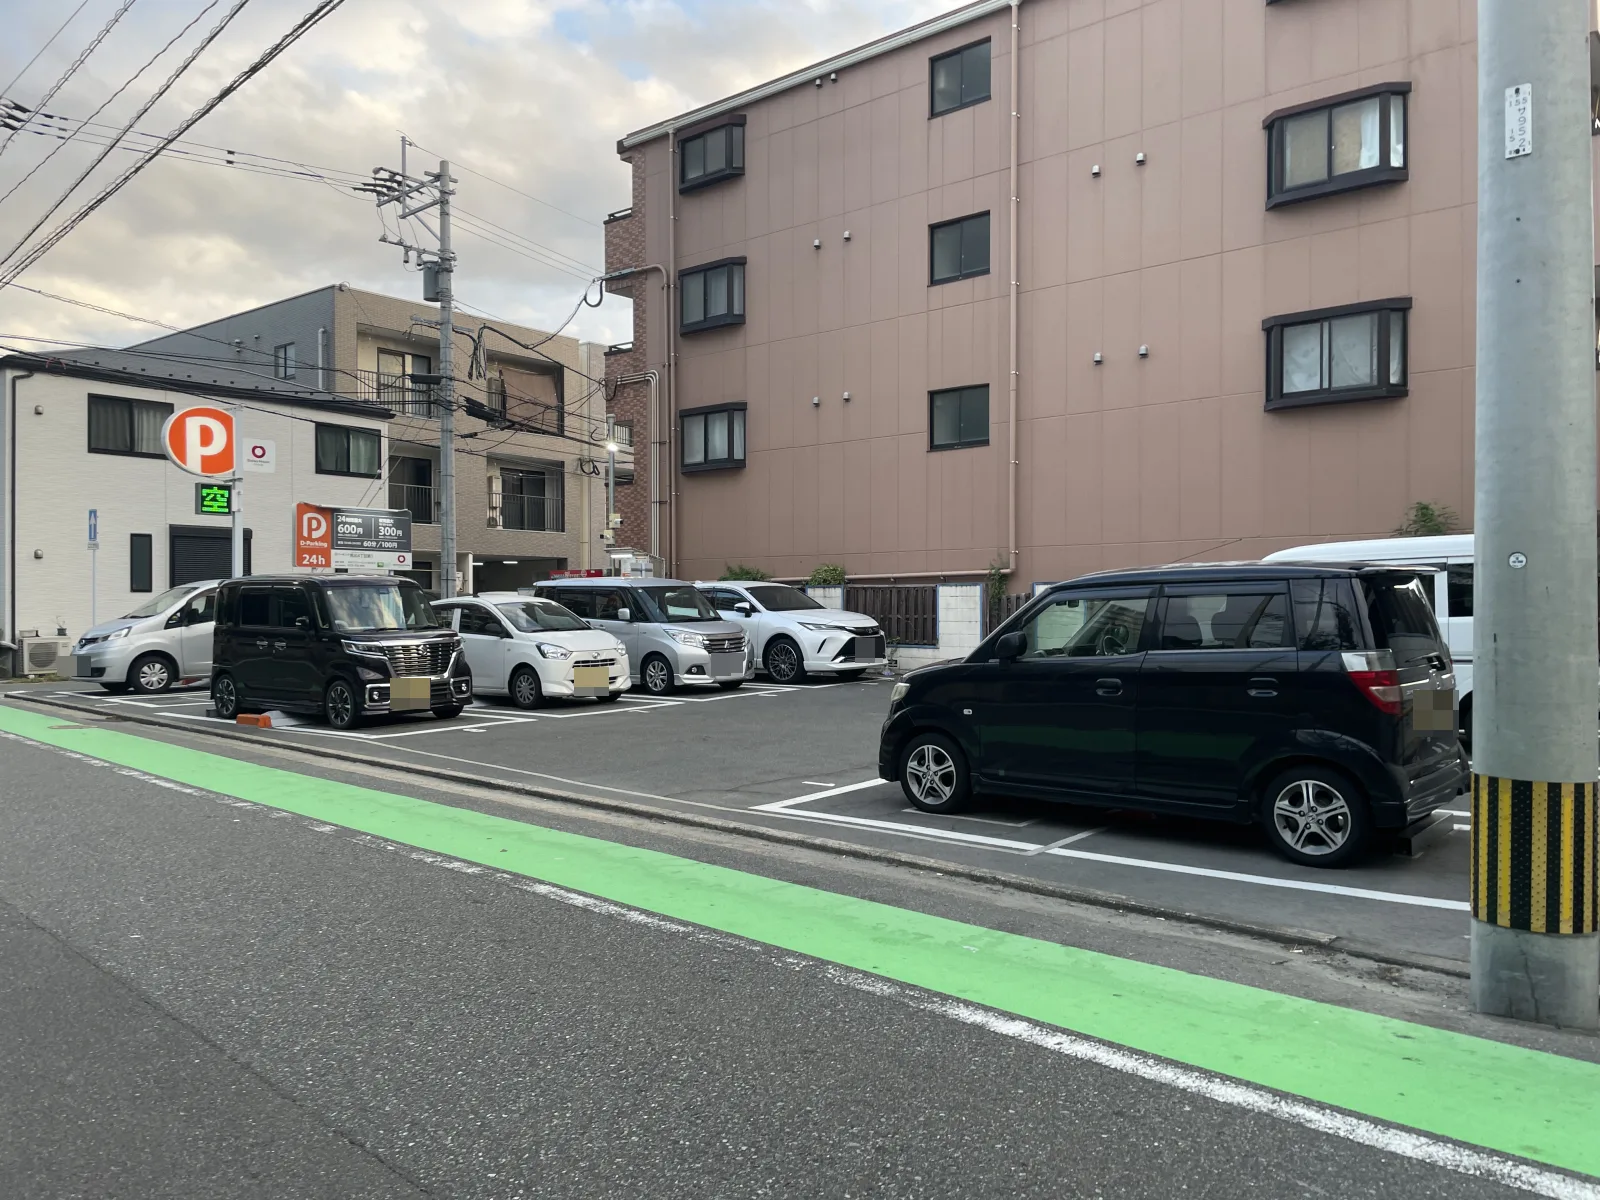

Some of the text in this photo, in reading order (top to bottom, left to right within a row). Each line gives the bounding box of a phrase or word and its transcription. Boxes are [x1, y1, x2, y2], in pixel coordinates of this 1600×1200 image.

[185, 416, 227, 473] P
[202, 487, 229, 512] 空
[337, 524, 363, 534] 600円
[378, 526, 403, 536] 300円
[302, 554, 325, 564] 24h
